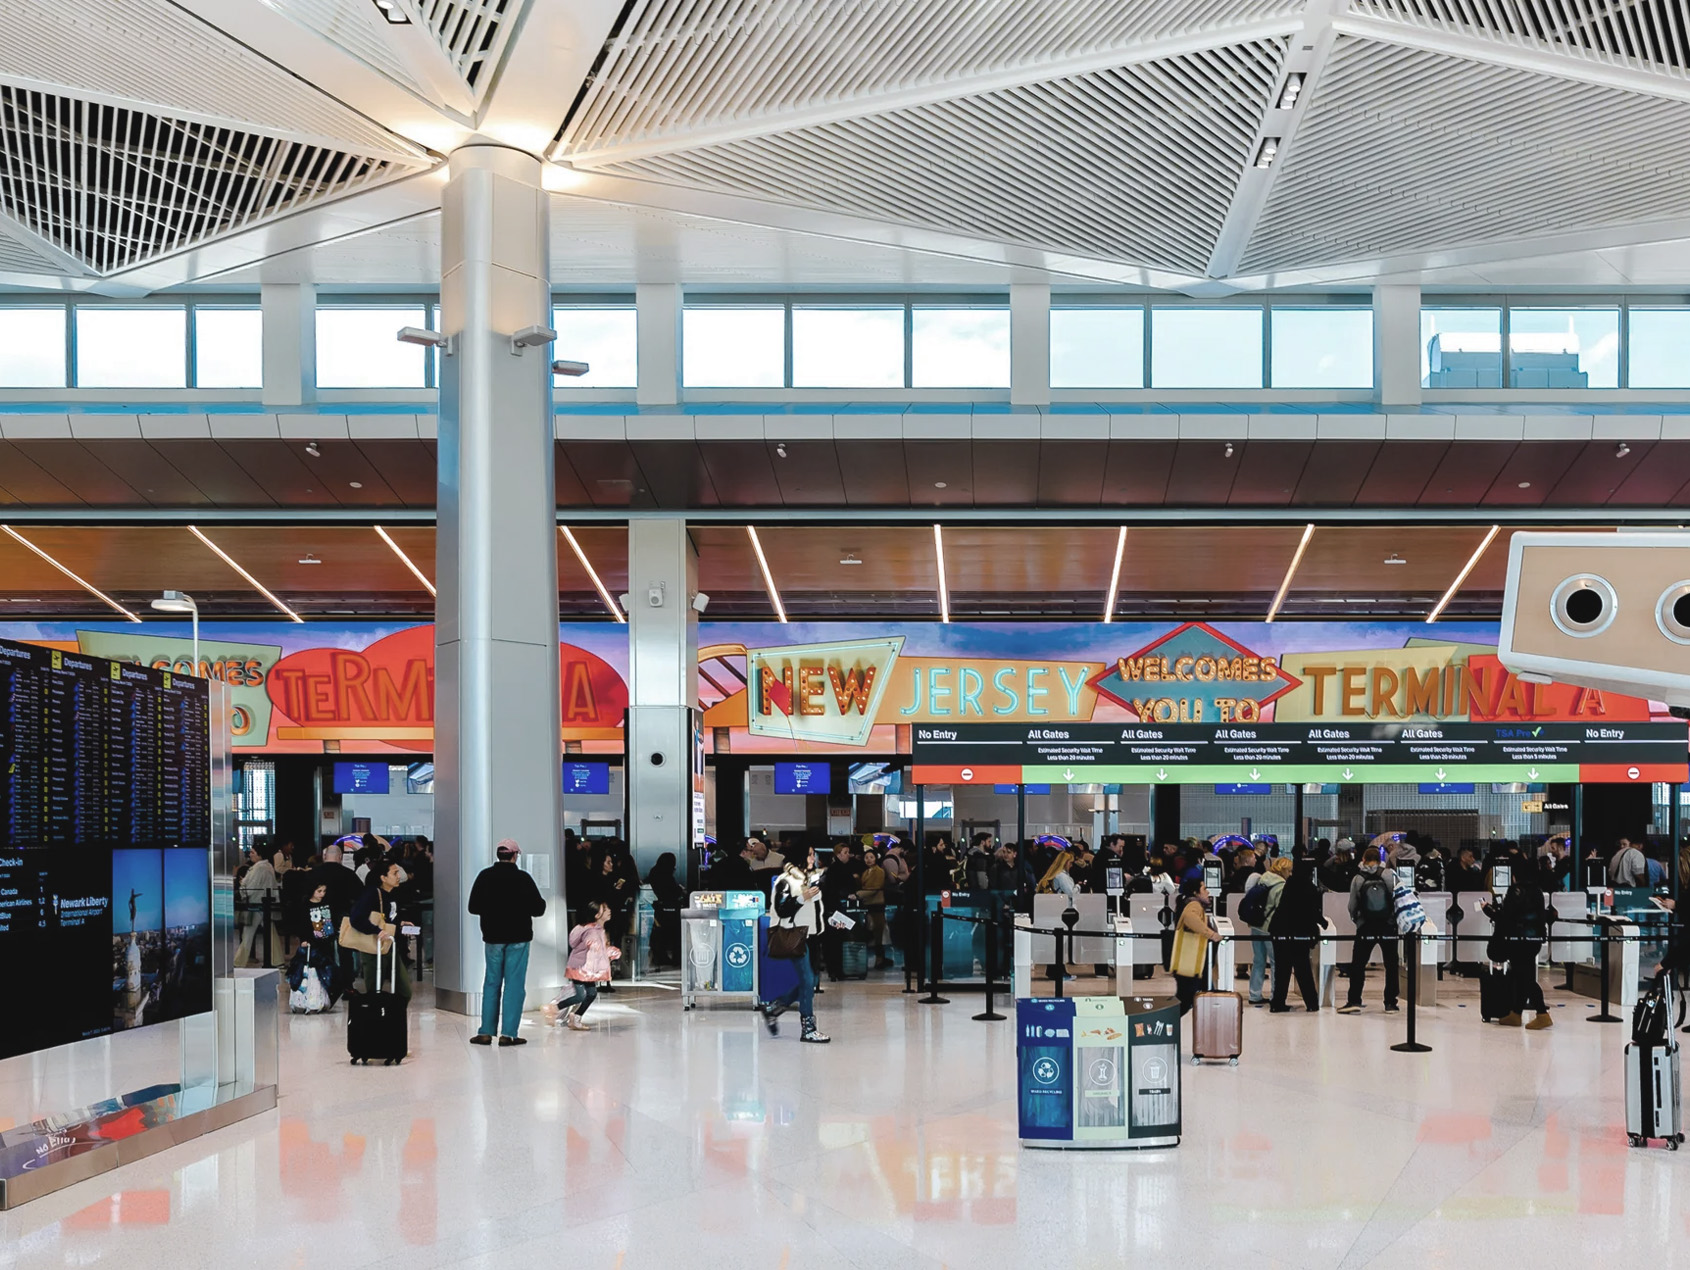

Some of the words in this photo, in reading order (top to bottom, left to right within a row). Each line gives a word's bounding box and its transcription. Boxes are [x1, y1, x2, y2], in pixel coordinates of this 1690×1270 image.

[0, 645, 31, 659] Departures
[64, 657, 93, 671] Departures
[1117, 656, 1278, 682] WELCOMES
[122, 668, 148, 681] Departures
[172, 678, 196, 690] Departures
[757, 658, 876, 717] NEW
[899, 666, 1093, 717] JERSEY
[567, 664, 602, 721] A
[1303, 665, 1557, 717] TERMINAL
[1577, 685, 1606, 716] A
[1133, 697, 1203, 723] YOU
[1214, 697, 1261, 723] TO
[918, 729, 931, 739] No
[932, 729, 958, 741] Entry
[1028, 729, 1040, 739] All
[1041, 729, 1070, 739] Gates
[1122, 729, 1134, 739] All
[1135, 729, 1164, 739] Gates
[1215, 729, 1227, 739] All
[1228, 729, 1257, 739] Gates
[1309, 729, 1321, 739] All
[1322, 729, 1351, 739] Gates
[1402, 729, 1414, 739] All
[1415, 729, 1444, 739] Gates
[1496, 729, 1514, 738] TSA
[1585, 729, 1599, 739] No
[1600, 729, 1625, 741] Entry
[1, 888, 18, 896] Canada
[15, 898, 32, 906] Airlines
[60, 898, 86, 909] Newark
[86, 896, 109, 908] Liberty
[60, 909, 88, 918] International
[88, 908, 103, 916] Airport
[60, 919, 80, 927] Terminal
